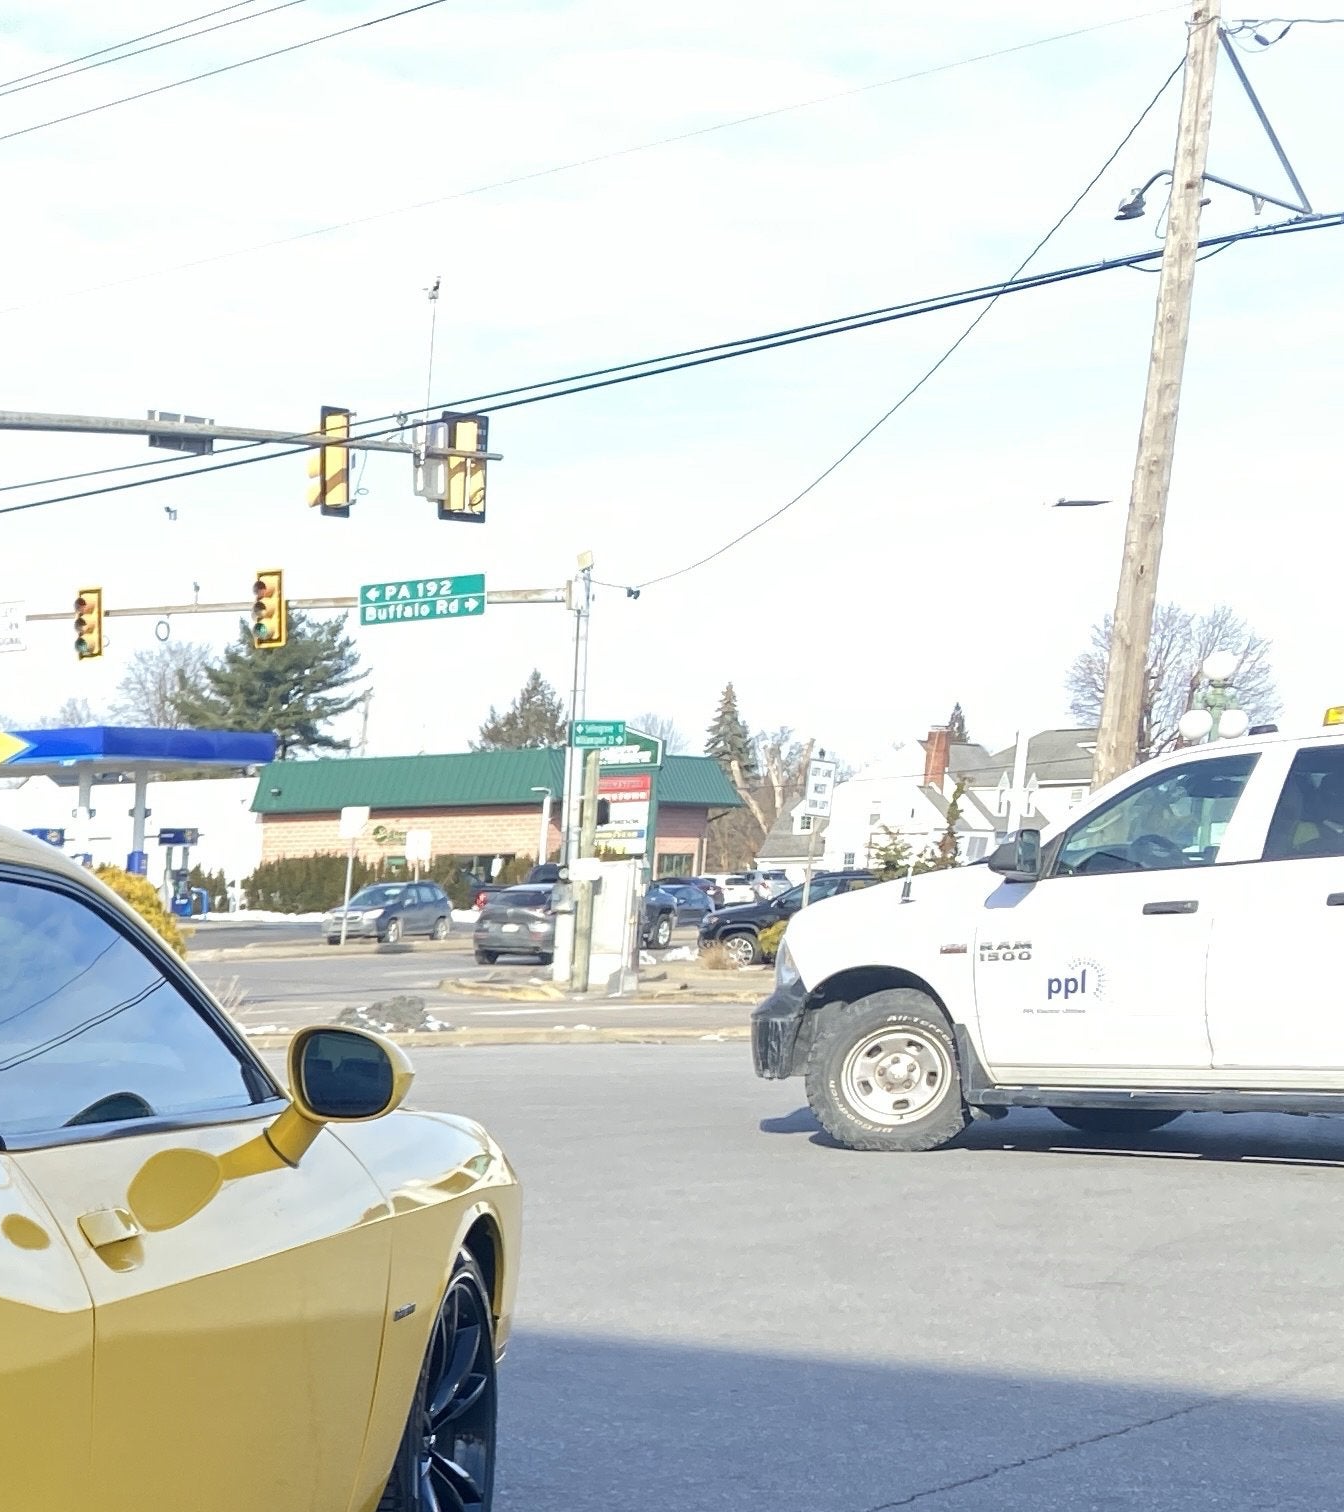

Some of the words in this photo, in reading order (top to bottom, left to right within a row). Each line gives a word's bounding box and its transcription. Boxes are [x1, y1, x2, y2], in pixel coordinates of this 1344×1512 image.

[385, 584, 411, 601] PA
[417, 580, 453, 598] 192
[365, 602, 431, 621] Buffalo
[436, 599, 459, 615] Rd
[979, 941, 1032, 951] RAM
[979, 951, 1032, 962] 1500
[1047, 969, 1086, 1000] ppl
